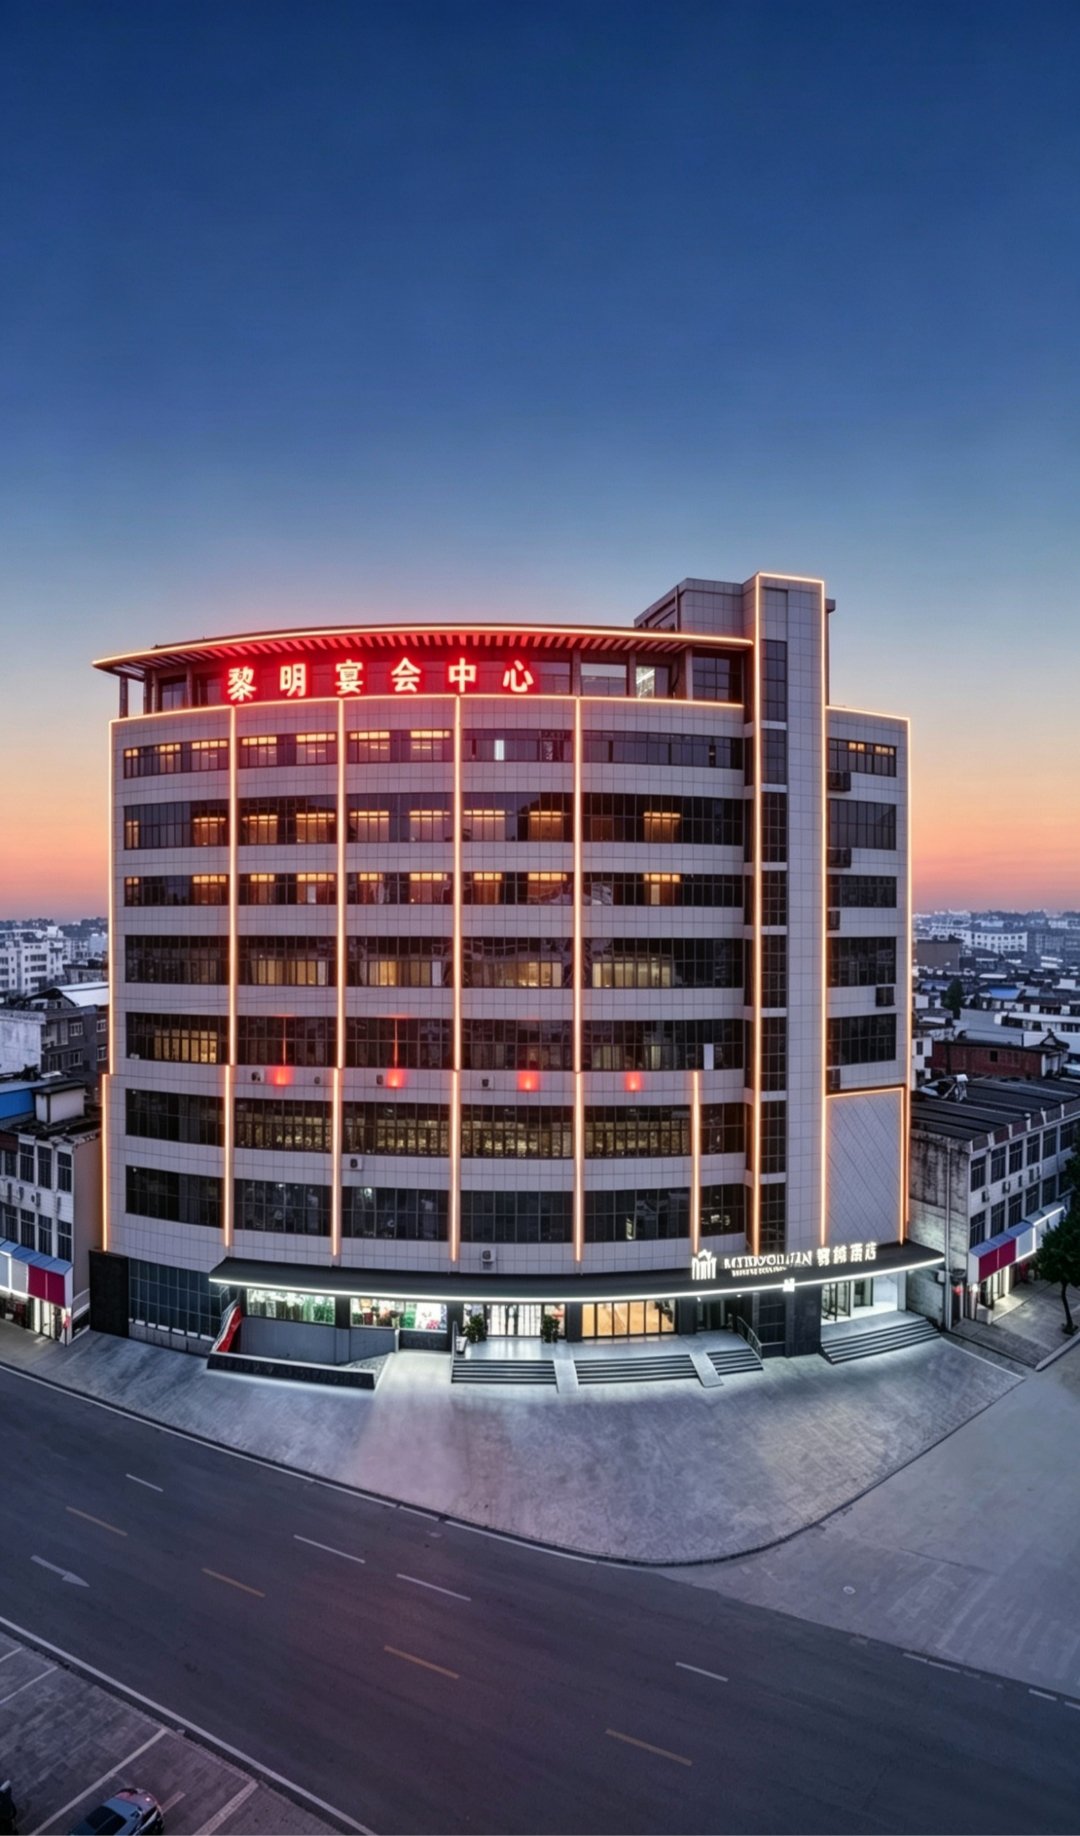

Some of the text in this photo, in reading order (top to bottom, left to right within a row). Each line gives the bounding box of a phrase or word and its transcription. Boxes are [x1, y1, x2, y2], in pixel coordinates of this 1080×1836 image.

[227, 657, 534, 701] 黎明宴会中心
